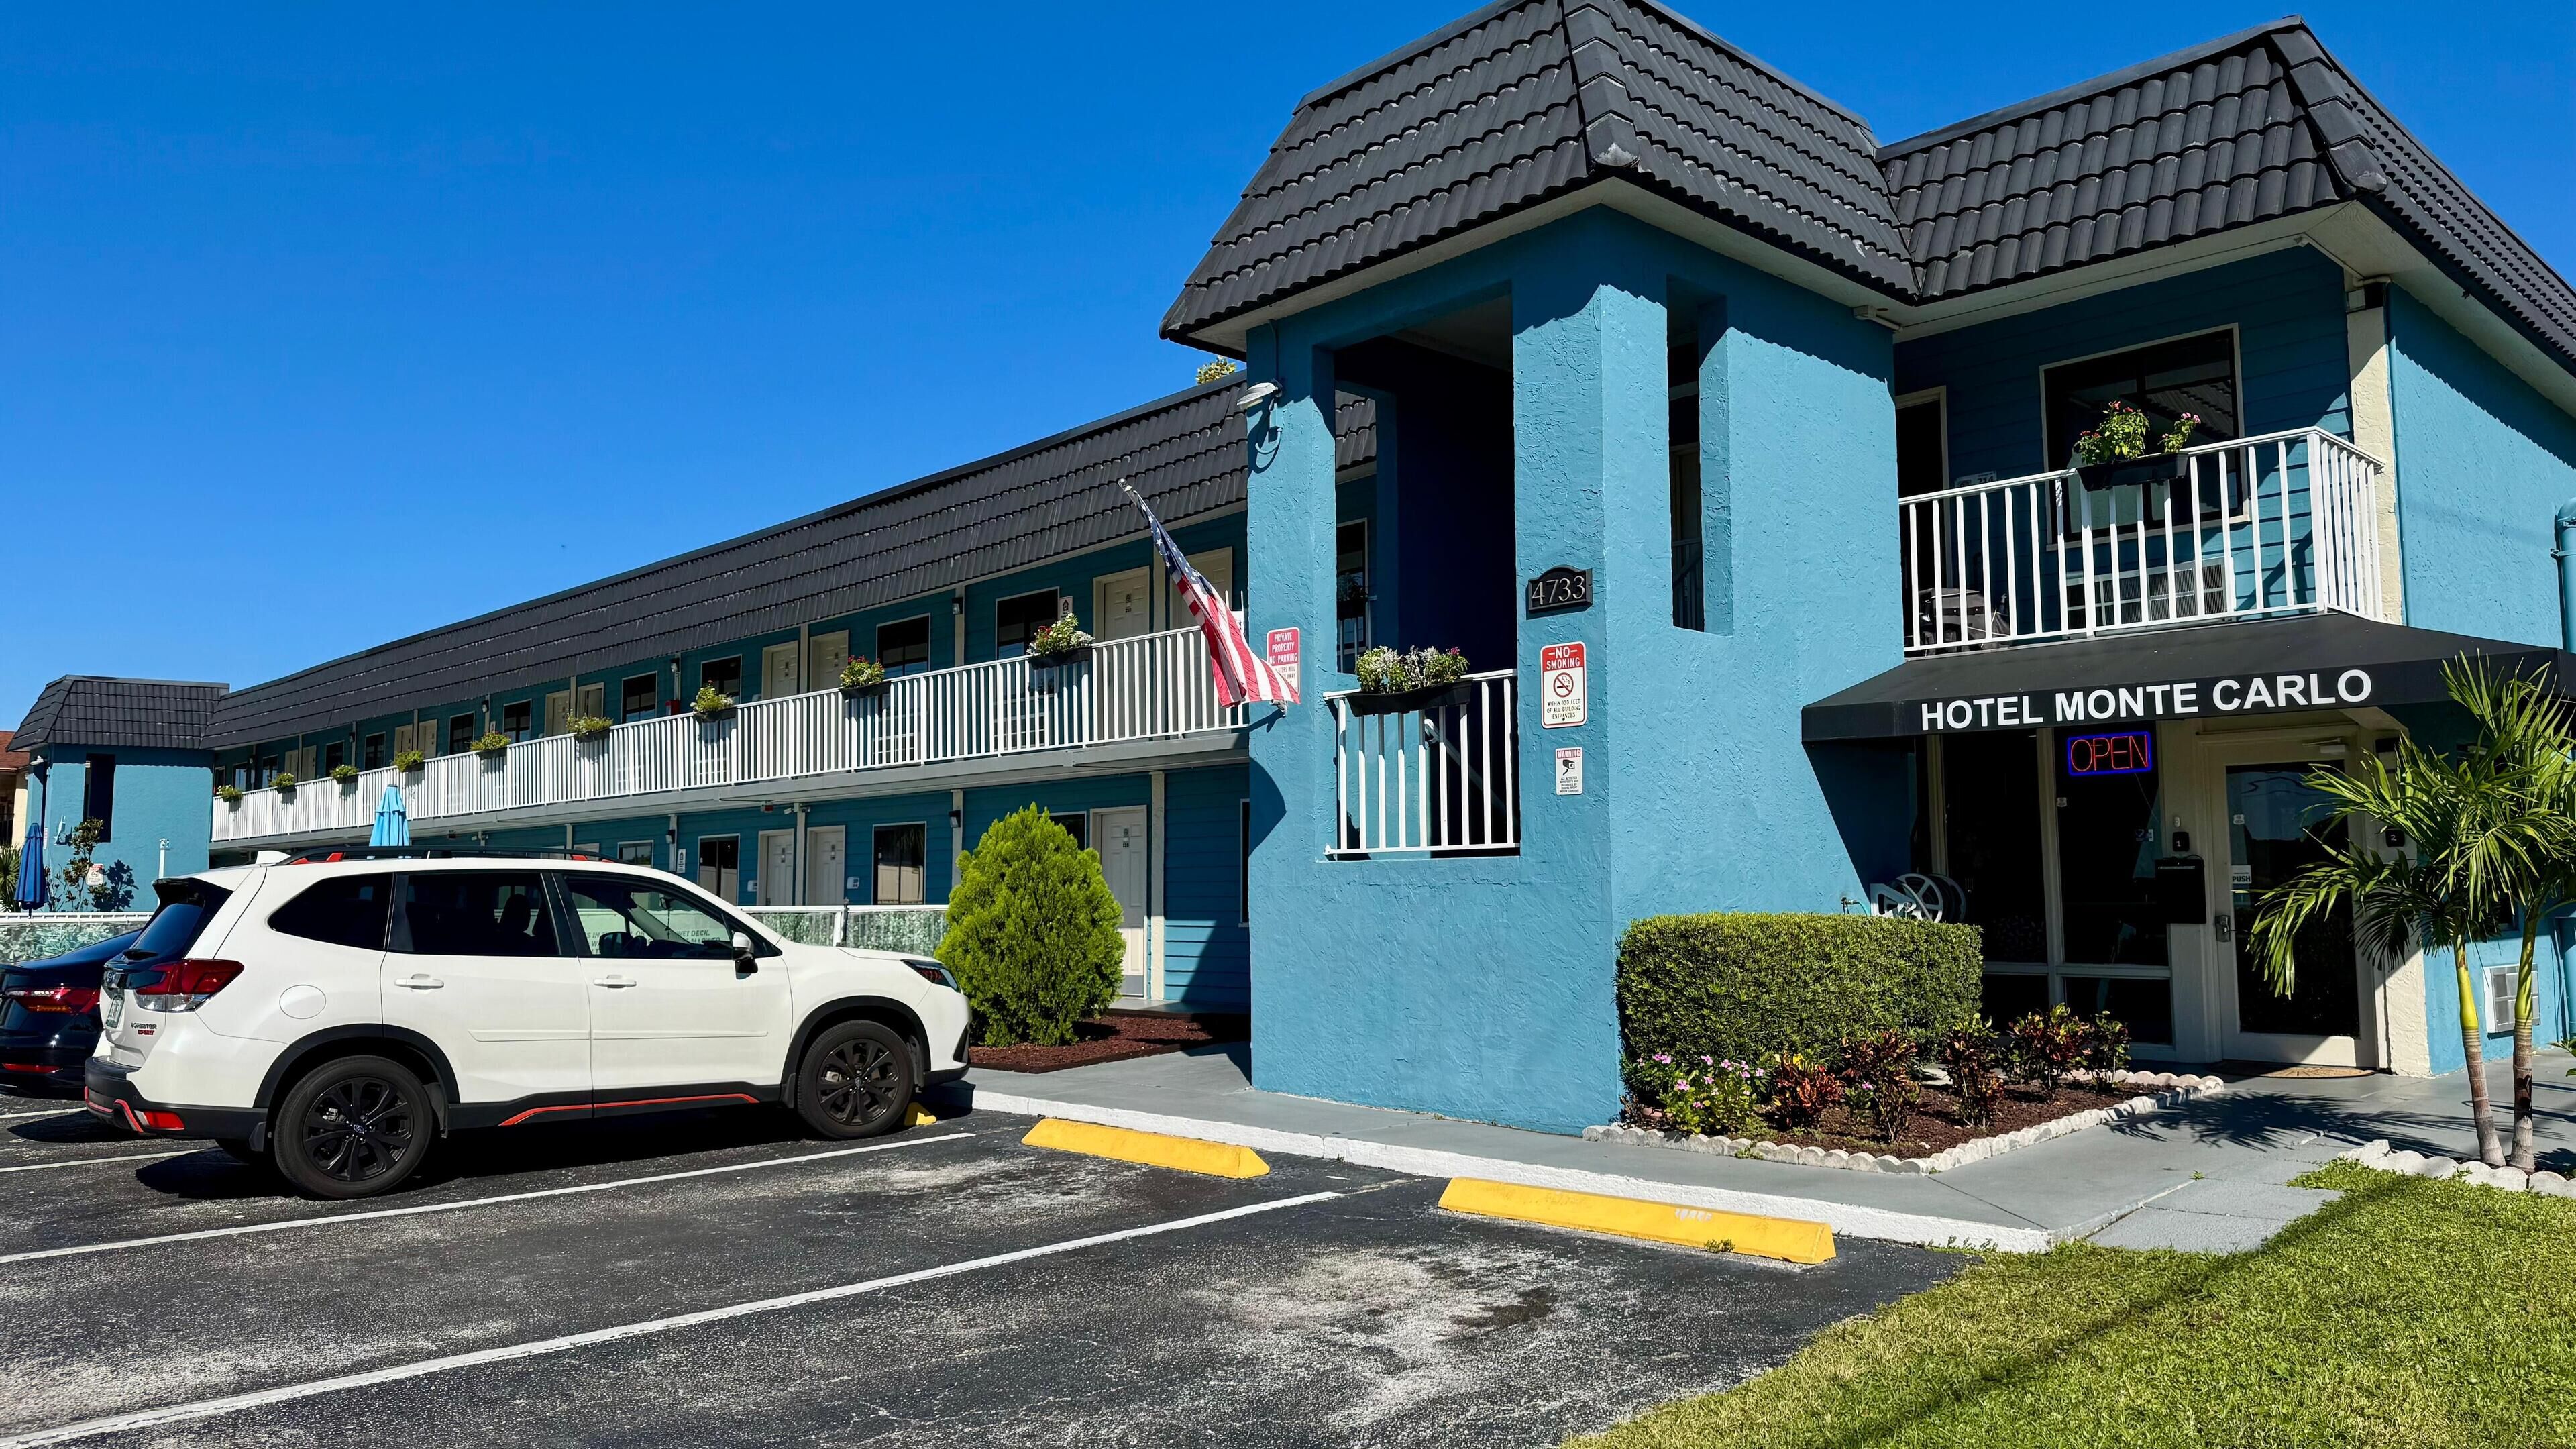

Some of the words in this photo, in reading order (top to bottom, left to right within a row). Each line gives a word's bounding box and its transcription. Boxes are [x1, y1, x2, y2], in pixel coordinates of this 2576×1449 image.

[1532, 576, 1585, 605] 4733
[1275, 632, 1292, 642] PRIVATE
[1272, 642, 1295, 653] PROPERTY
[1556, 646, 1570, 659] NO
[1269, 656, 1276, 665] NO
[1278, 653, 1298, 663] PARKING
[1546, 657, 1580, 670] SMOKING
[1921, 696, 2043, 731] HOTEL
[2055, 682, 2199, 722] MONTE
[2212, 669, 2372, 711] CARLO
[1557, 749, 1580, 758] WARNING
[2070, 735, 2149, 771] OPEN
